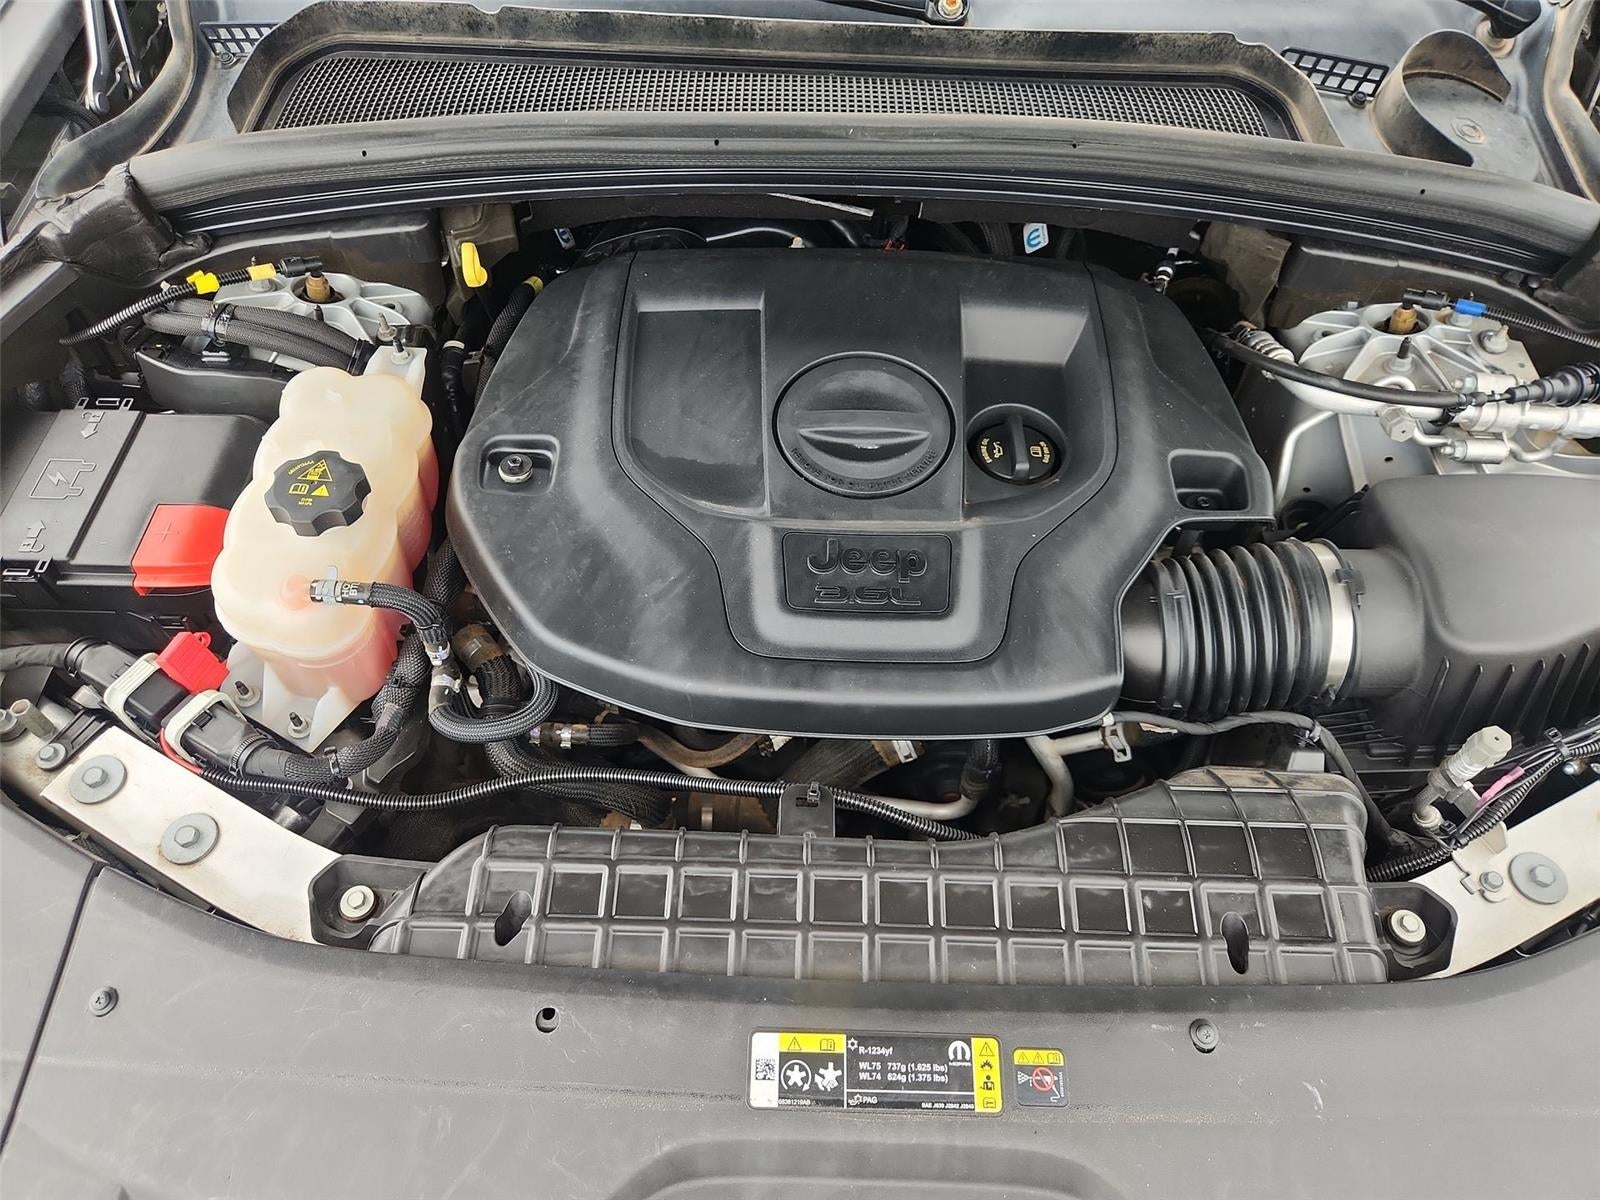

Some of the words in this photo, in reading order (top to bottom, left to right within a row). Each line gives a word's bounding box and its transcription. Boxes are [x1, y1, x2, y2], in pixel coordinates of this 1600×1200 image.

[904, 449, 938, 479] SERVICE
[806, 538, 928, 584] Jeep
[814, 584, 922, 606] 3.6L
[858, 1046, 894, 1057] R-1234yf
[859, 1061, 882, 1071] WL75
[887, 1062, 907, 1073] 737g
[907, 1062, 932, 1073] (1.625
[932, 1063, 949, 1074] lbs)
[859, 1071, 882, 1081] WL74
[887, 1072, 907, 1083] 624g
[907, 1072, 932, 1084] (1.375
[932, 1073, 949, 1084] lbs)
[862, 1095, 878, 1104] PAG
